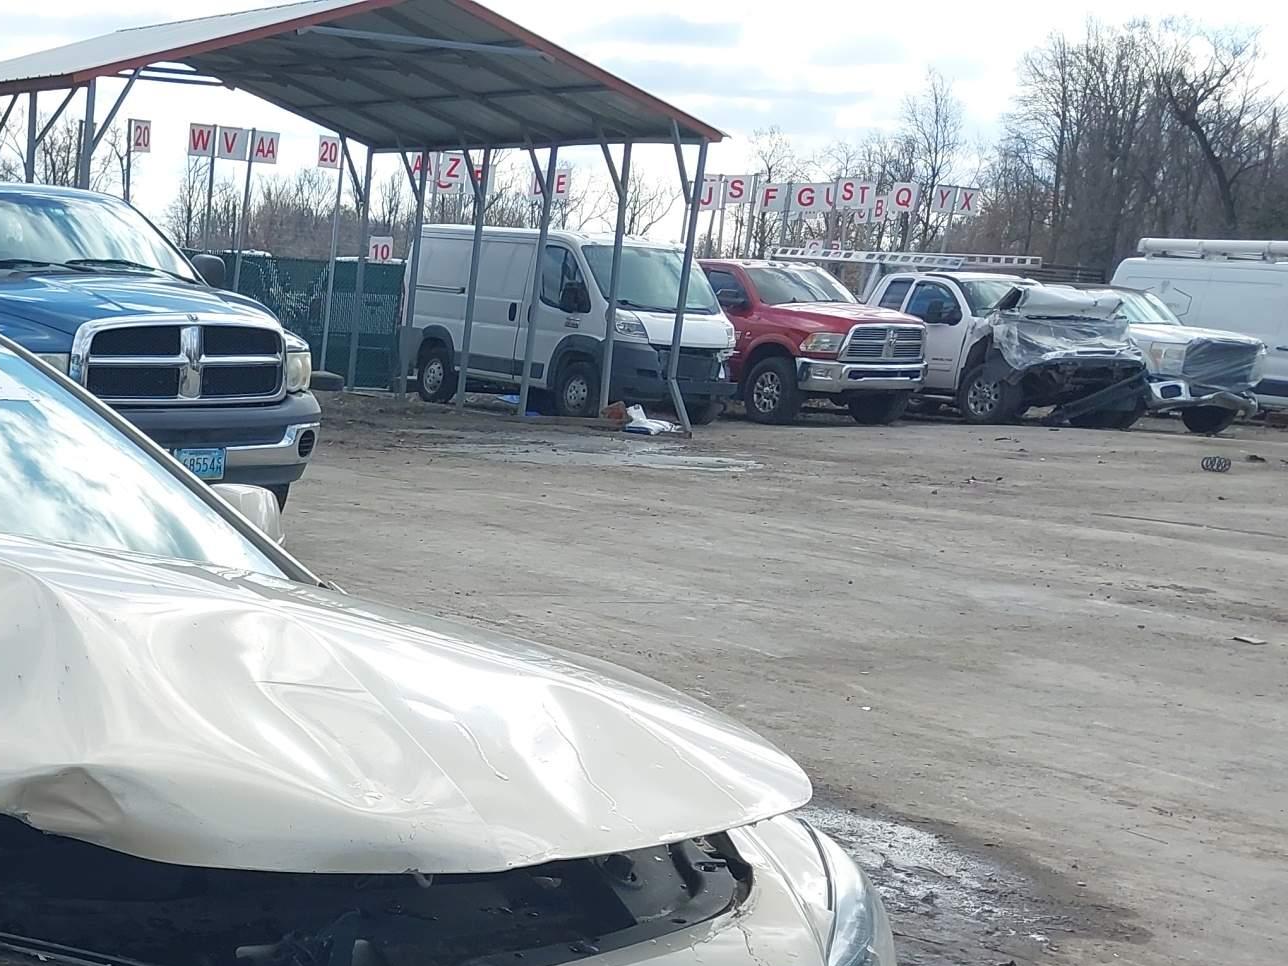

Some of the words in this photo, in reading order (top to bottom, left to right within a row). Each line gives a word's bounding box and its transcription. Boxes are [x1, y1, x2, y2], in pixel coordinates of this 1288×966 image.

[135, 125, 151, 147] 20
[191, 129, 212, 151] W
[223, 132, 238, 154] V
[256, 137, 276, 159] AA
[320, 141, 337, 163] 20
[446, 158, 461, 178] Z
[556, 174, 567, 194] E
[728, 179, 745, 199] S
[842, 182, 854, 201] S
[764, 188, 778, 207] F
[797, 187, 816, 207] G
[860, 186, 870, 205] T
[895, 187, 912, 208] Q
[939, 189, 951, 209] Y
[961, 192, 974, 212] X
[874, 199, 884, 218] B
[371, 243, 390, 261] 10
